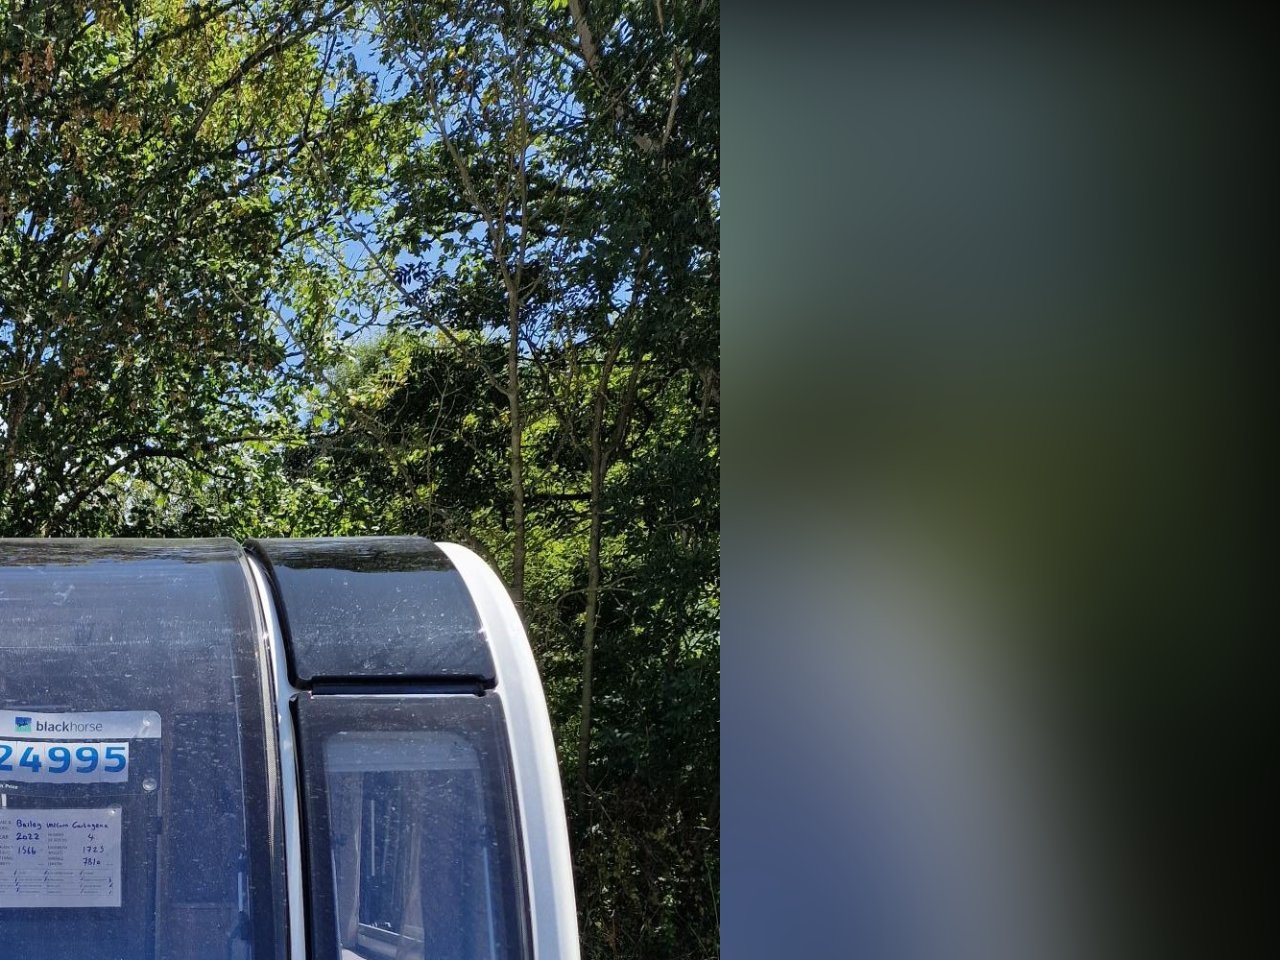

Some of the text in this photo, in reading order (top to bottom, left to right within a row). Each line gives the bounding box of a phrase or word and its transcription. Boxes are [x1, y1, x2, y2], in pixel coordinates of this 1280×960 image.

[36, 721, 103, 732] blackhorse
[16, 819, 42, 830] Bailey
[16, 832, 40, 840] 2022
[87, 833, 95, 841] 4
